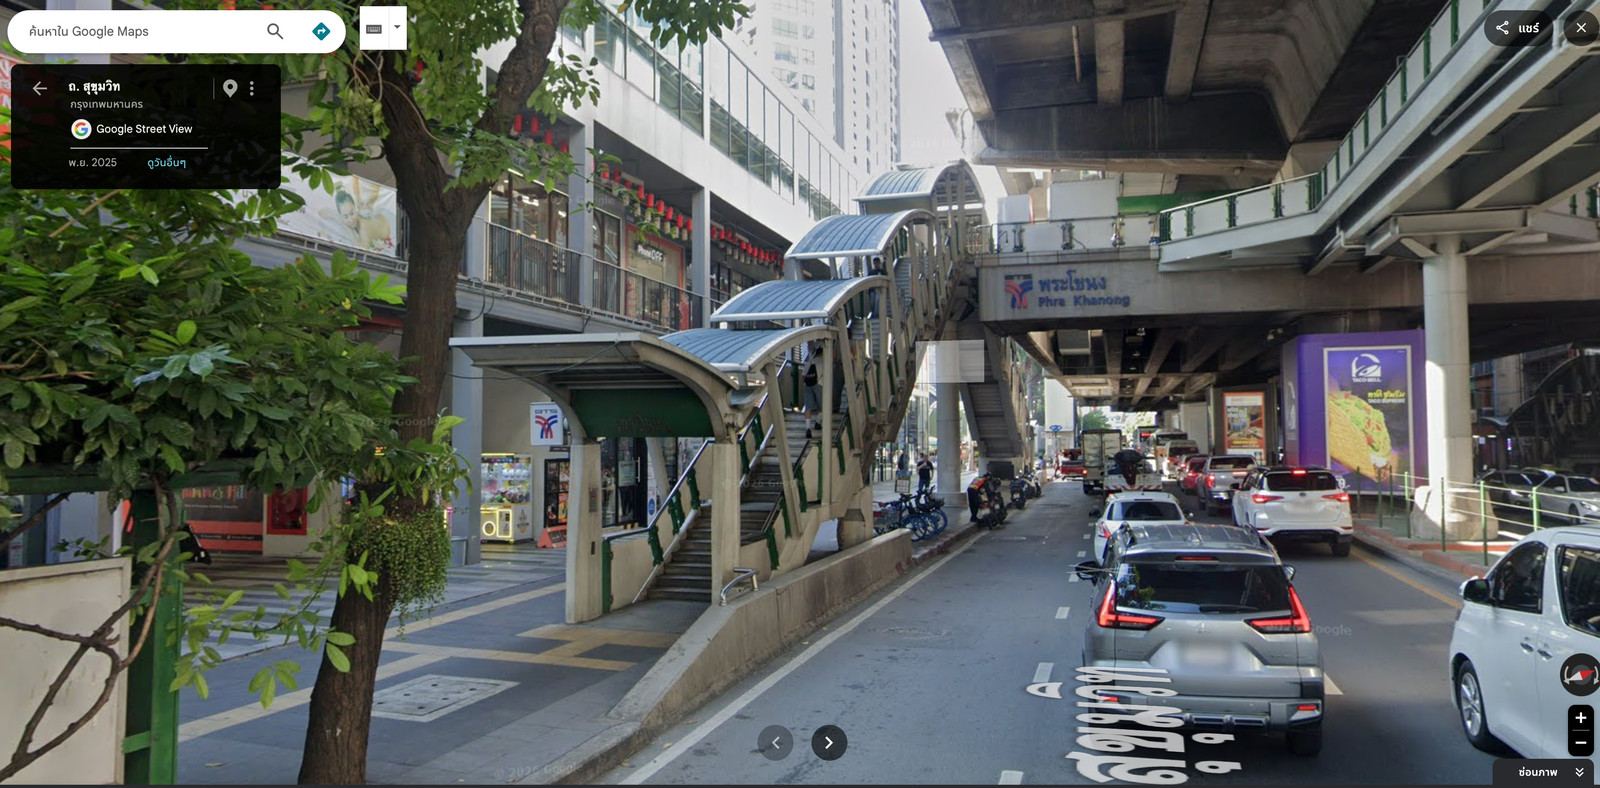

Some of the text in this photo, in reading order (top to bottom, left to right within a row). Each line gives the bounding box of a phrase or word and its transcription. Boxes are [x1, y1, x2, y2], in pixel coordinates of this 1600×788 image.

[1038, 268, 1107, 292] พระโขนง
[1038, 294, 1131, 308] Phra Khanong
